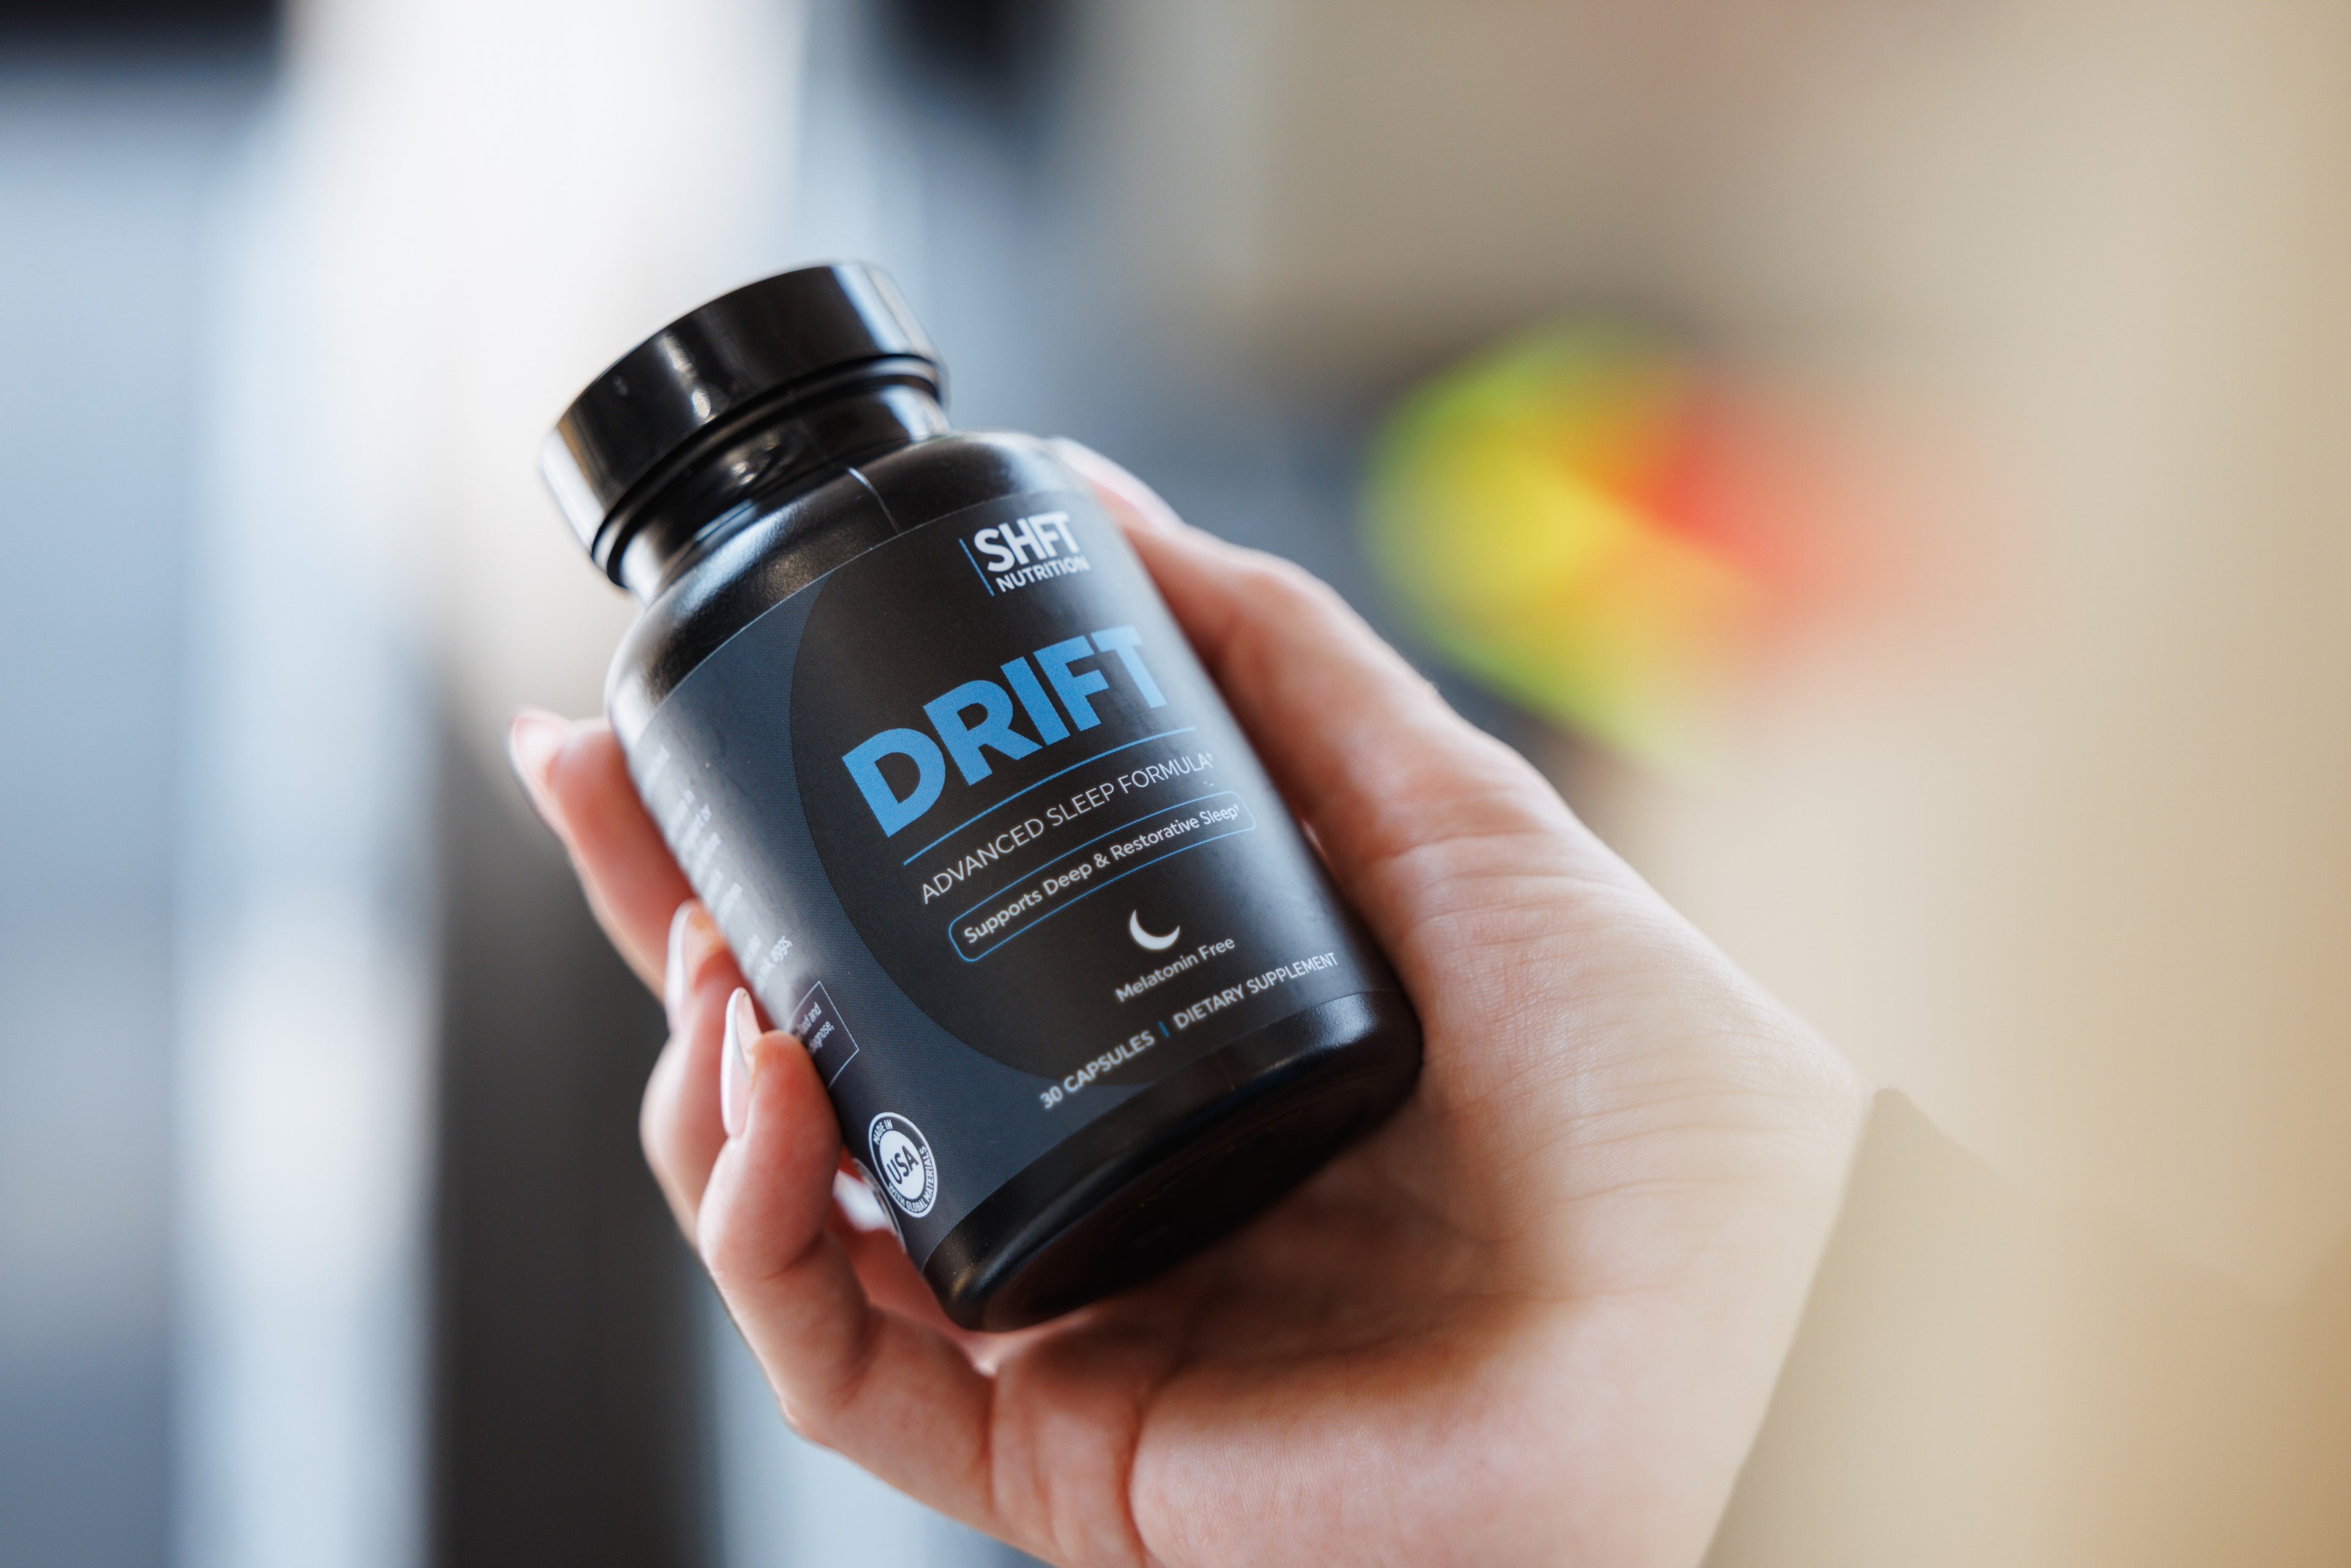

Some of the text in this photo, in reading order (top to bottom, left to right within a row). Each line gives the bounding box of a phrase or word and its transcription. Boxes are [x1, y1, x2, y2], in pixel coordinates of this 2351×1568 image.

[975, 511, 1080, 572] SHFT
[996, 555, 1090, 593] NUTRITION
[842, 624, 1167, 837] DRIFT
[921, 818, 1044, 904] ADVANCED
[1047, 782, 1115, 827] SLEEP
[964, 889, 1043, 943] Supports
[1043, 862, 1093, 895] Deep
[1093, 852, 1110, 868] &
[1110, 815, 1200, 860] Restorative
[1115, 937, 1235, 1002] Melatonin Free
[1040, 952, 1338, 1108] 30 CAPSULES DIETARY SUPPLEMENT
[873, 1119, 893, 1144] MADE IN
[887, 1145, 919, 1185] USA
[906, 1198, 928, 1212] GLOBAL
[920, 1146, 934, 1202] MATERIALS
